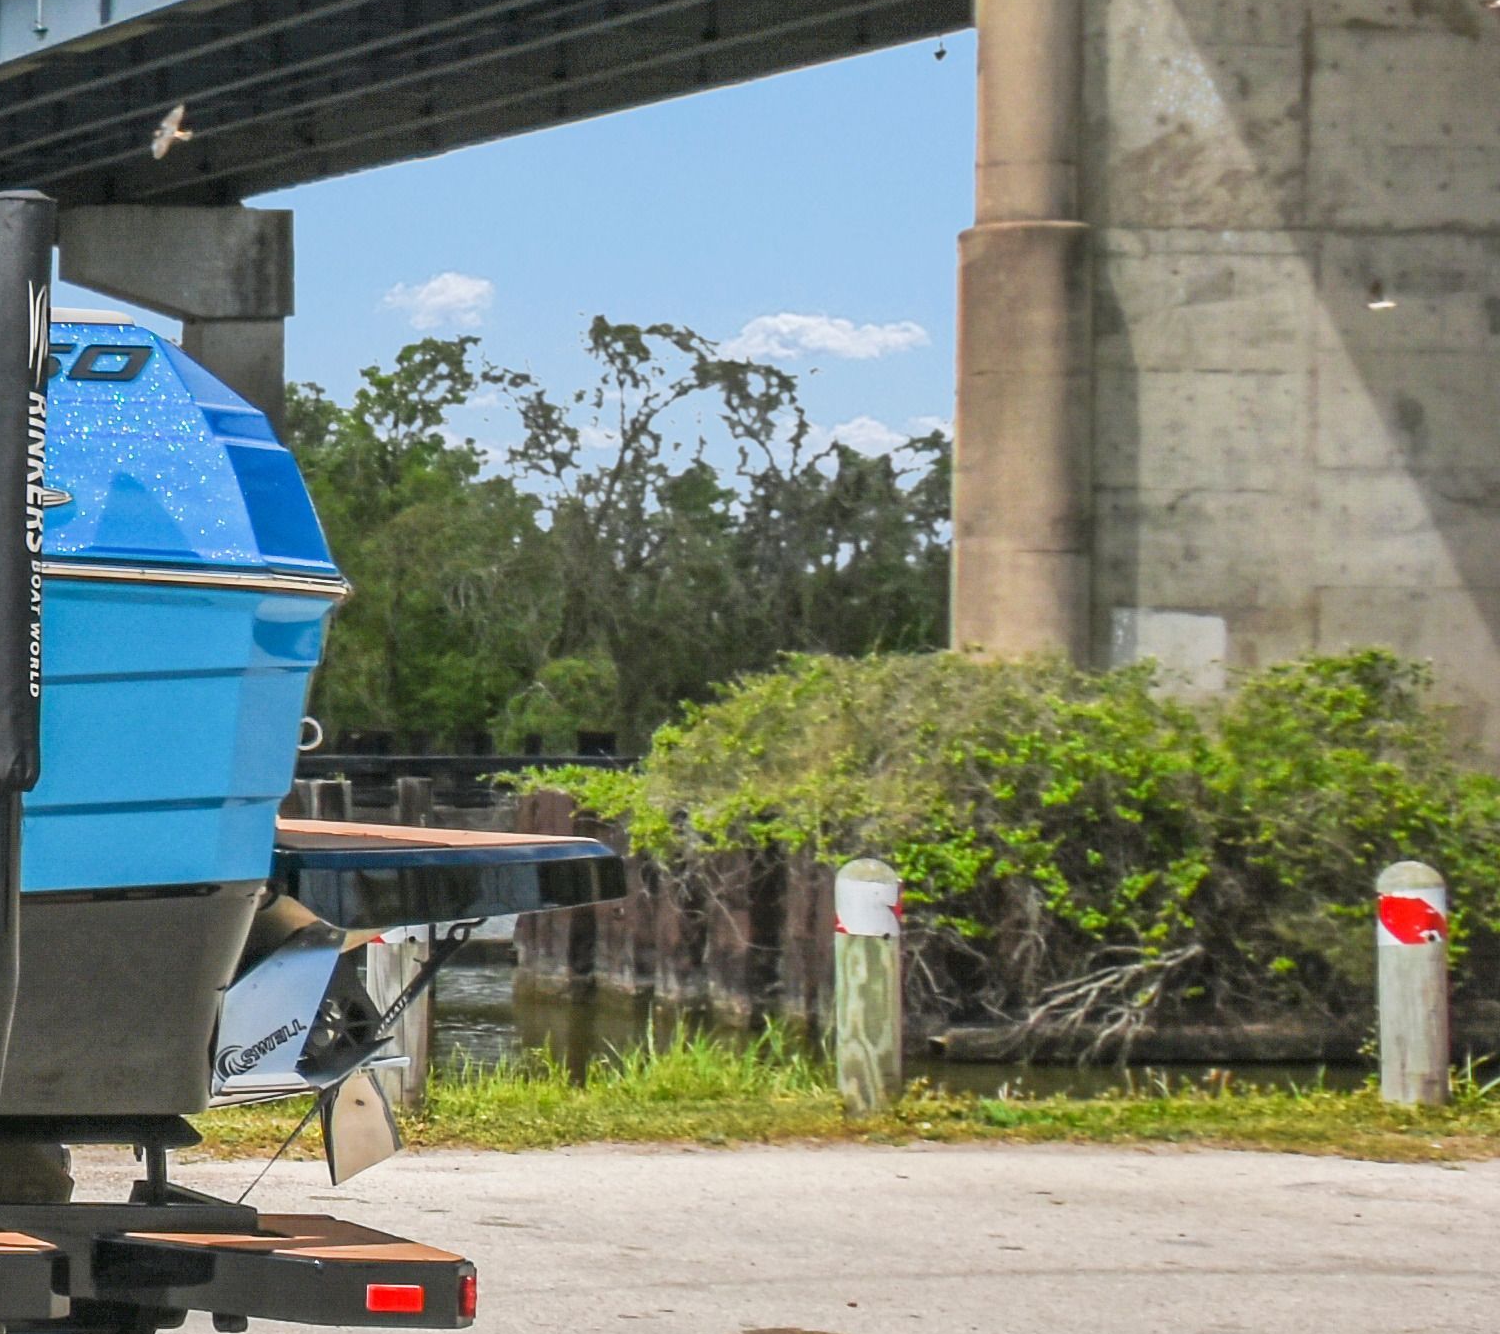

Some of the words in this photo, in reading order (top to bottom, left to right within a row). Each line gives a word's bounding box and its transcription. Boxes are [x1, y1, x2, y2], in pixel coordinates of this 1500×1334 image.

[26, 390, 47, 555] RINKERS
[30, 559, 41, 617] BOAT
[29, 622, 41, 698] WORLD
[240, 1019, 308, 1067] SWELL
